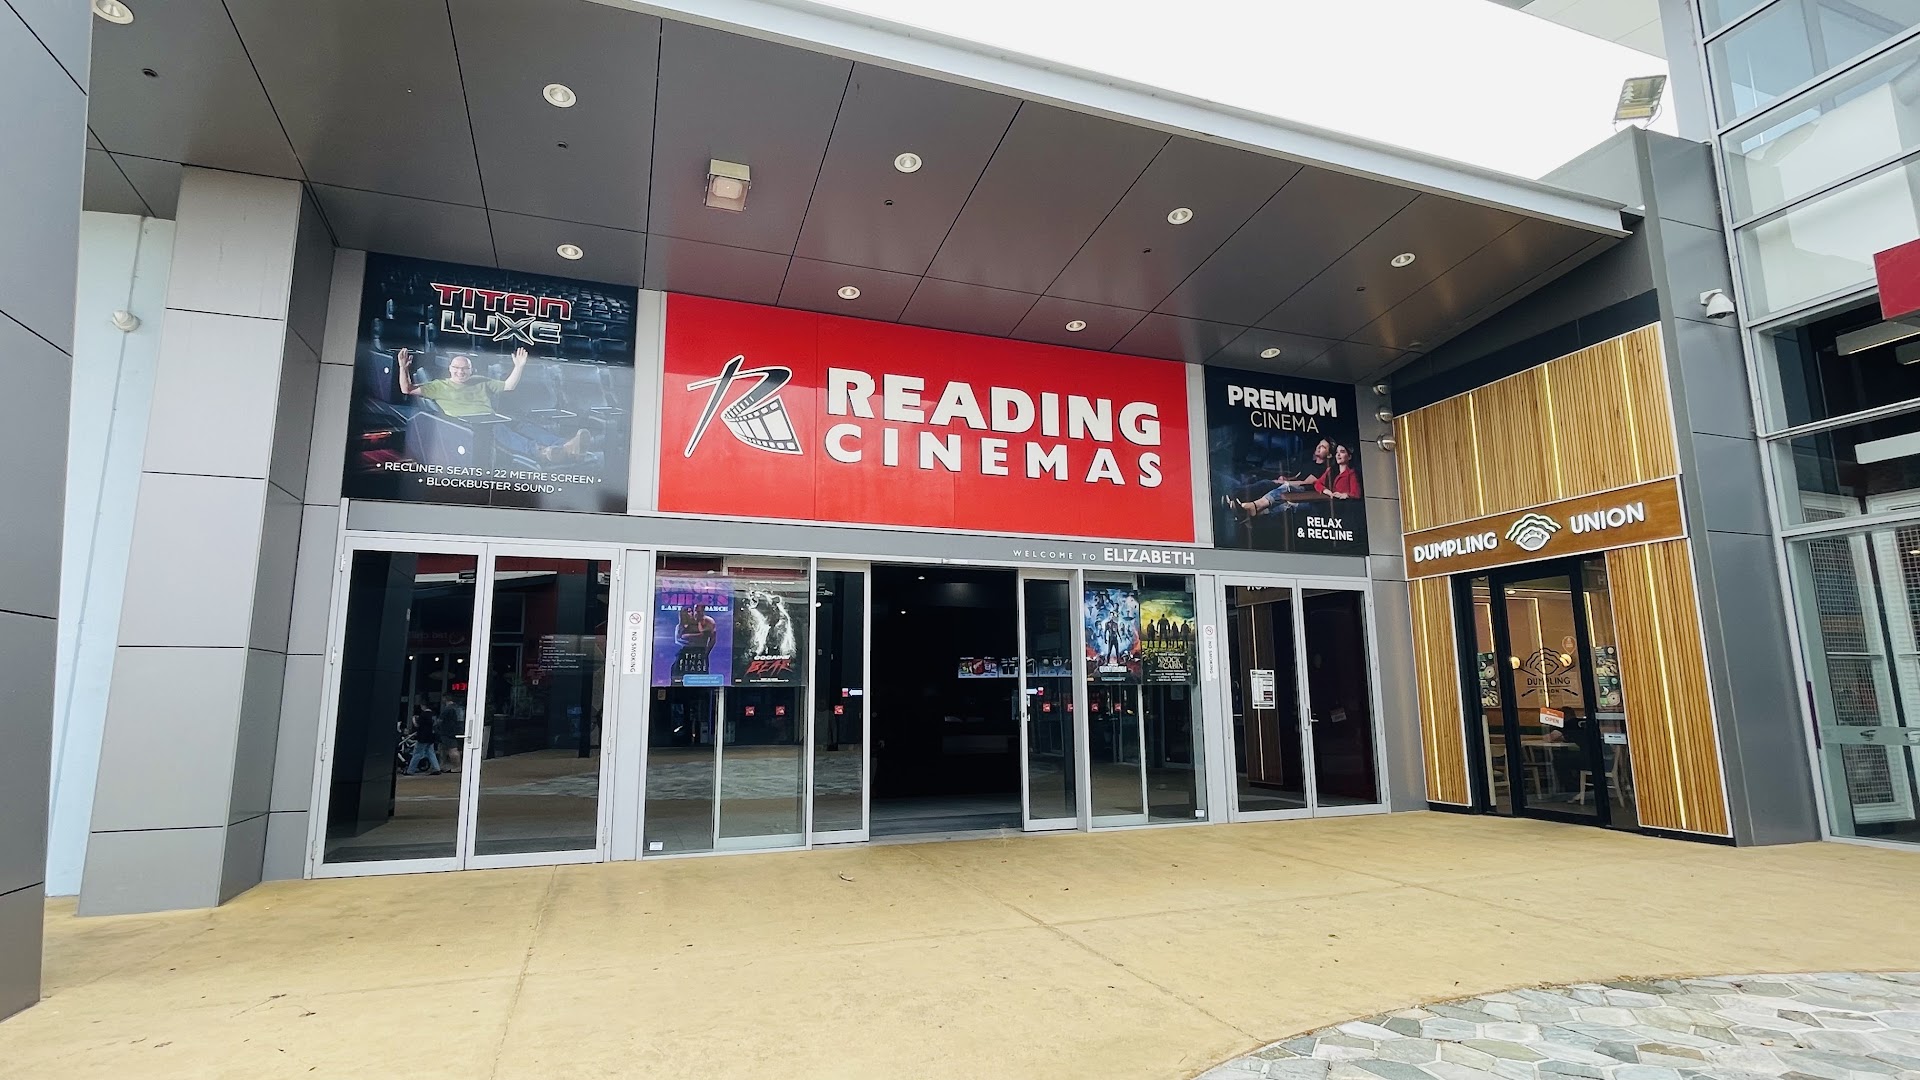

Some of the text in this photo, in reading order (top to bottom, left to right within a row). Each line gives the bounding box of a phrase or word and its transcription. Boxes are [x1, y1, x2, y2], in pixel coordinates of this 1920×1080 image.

[430, 282, 572, 320] TITAN
[441, 311, 562, 346] LUXE
[826, 366, 1162, 446] READING
[1228, 385, 1338, 417] PREMIUM
[1250, 410, 1319, 433] CINEMA
[824, 423, 1163, 488] CINEMAS
[384, 462, 594, 484] RECLINER SEATS 22 METRE SCREEN
[426, 477, 554, 494] BLOCKBUSTER SOUND
[1306, 516, 1343, 529] RELAX
[1414, 501, 1645, 563] DUMPLING UNION
[1297, 528, 1353, 541] & RECLINE
[1012, 548, 1195, 566] WELCOME TO ELIZABETH
[632, 631, 637, 641] NO
[1545, 716, 1559, 724] OPEN
